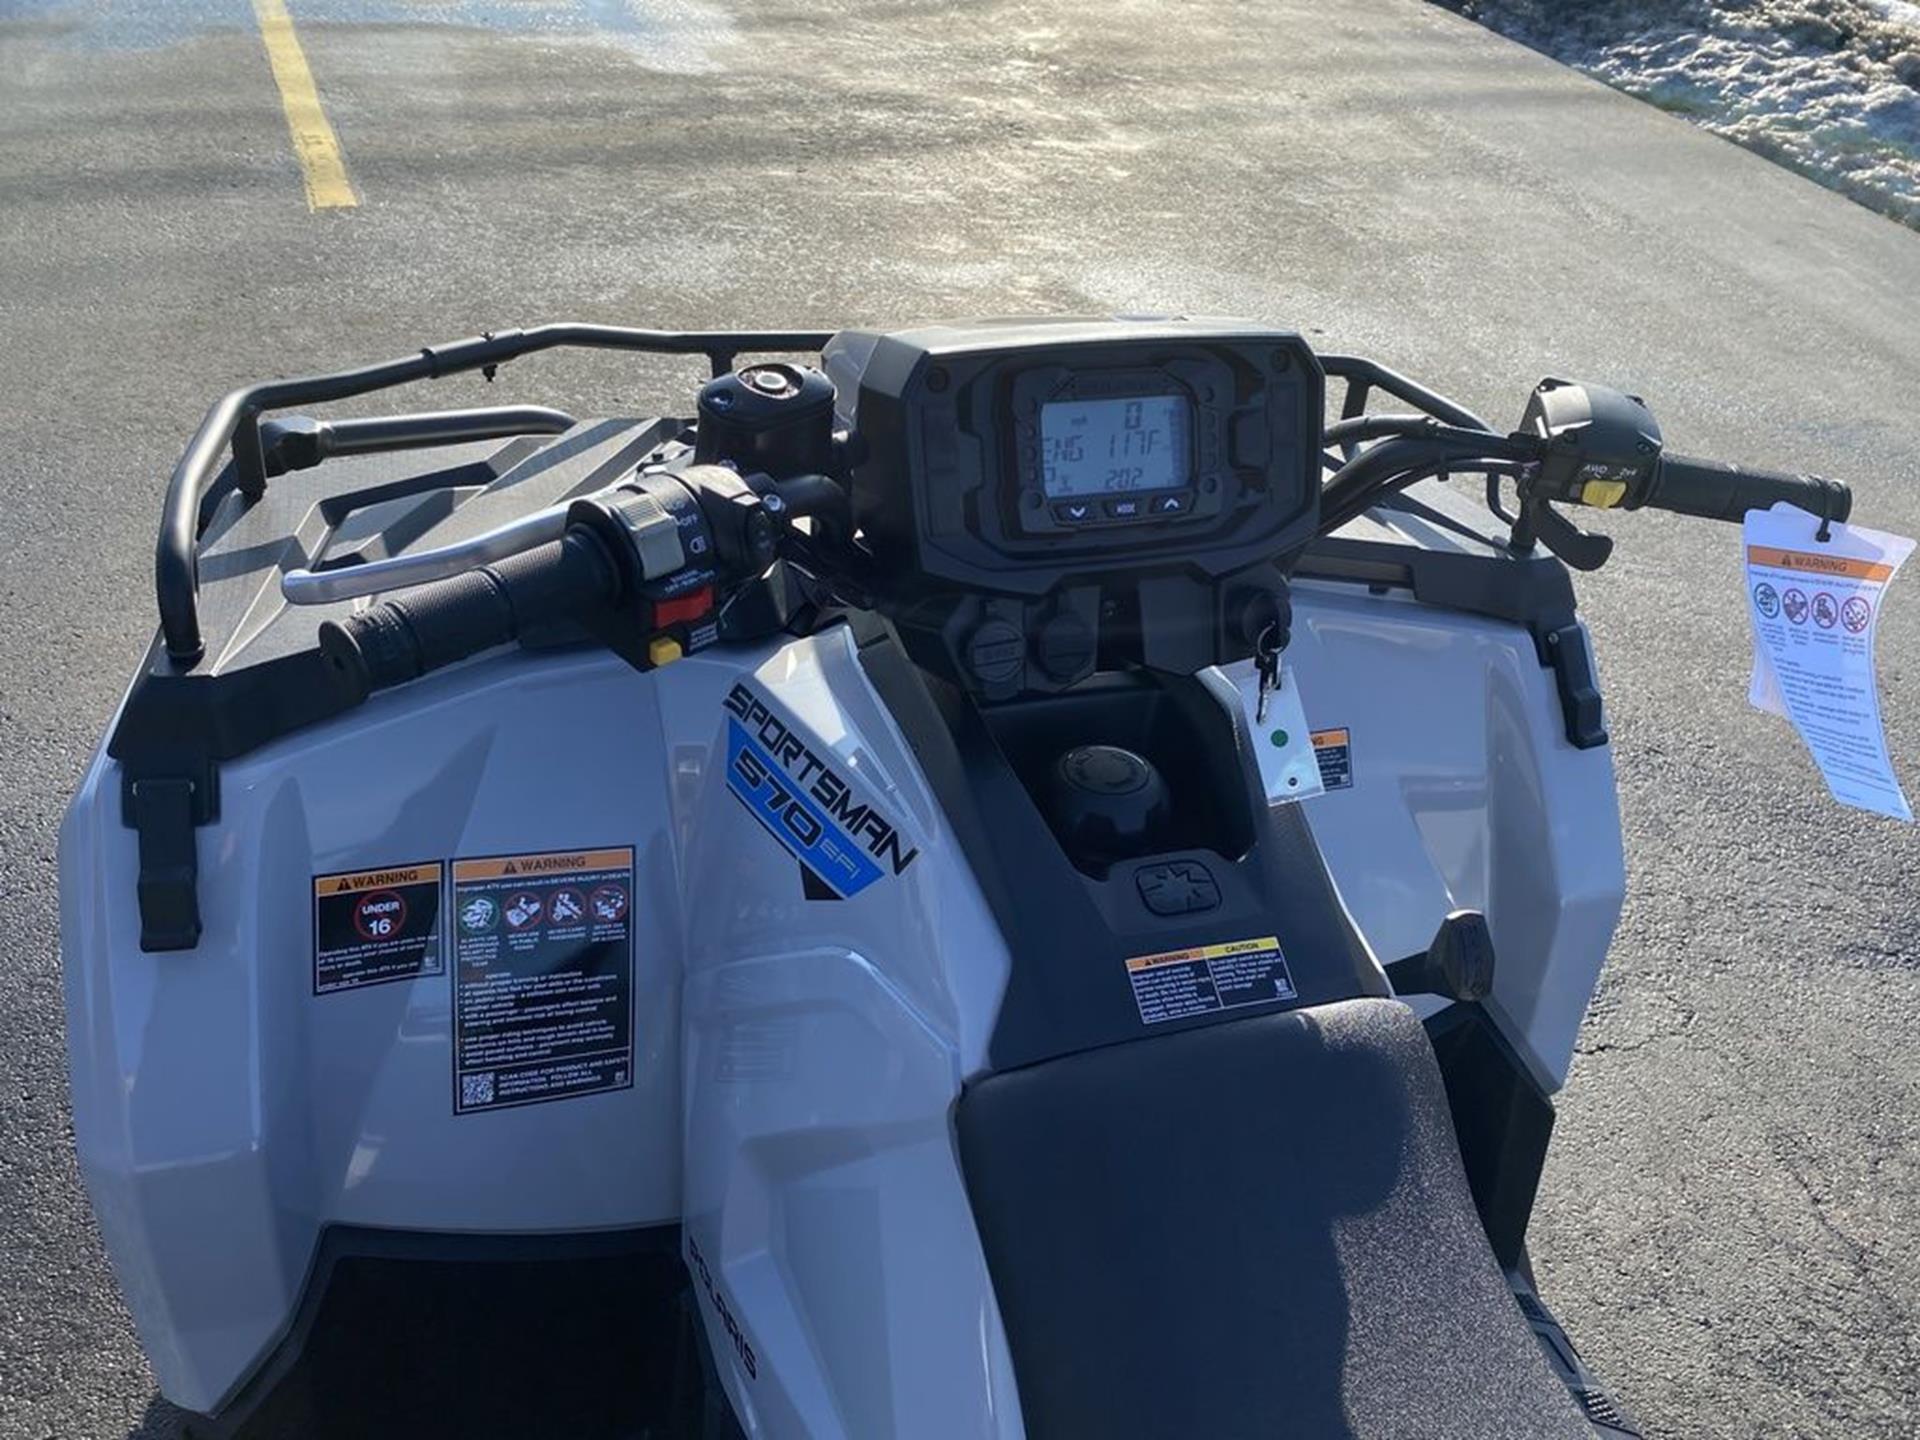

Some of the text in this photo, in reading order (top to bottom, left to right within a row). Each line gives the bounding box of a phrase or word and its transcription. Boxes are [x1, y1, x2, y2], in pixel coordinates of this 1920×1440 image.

[1125, 402, 1142, 429] 0
[1794, 556, 1848, 573] WARNING
[722, 683, 920, 876] SPORTSMAN
[733, 746, 823, 848] 570
[520, 856, 587, 872] WARNING
[820, 838, 862, 880] EFI
[353, 870, 418, 889] WARNING
[362, 901, 400, 915] UNDER
[369, 919, 391, 935] 16
[1225, 943, 1259, 953] CAUTION
[689, 1236, 757, 1381] POLARIS
